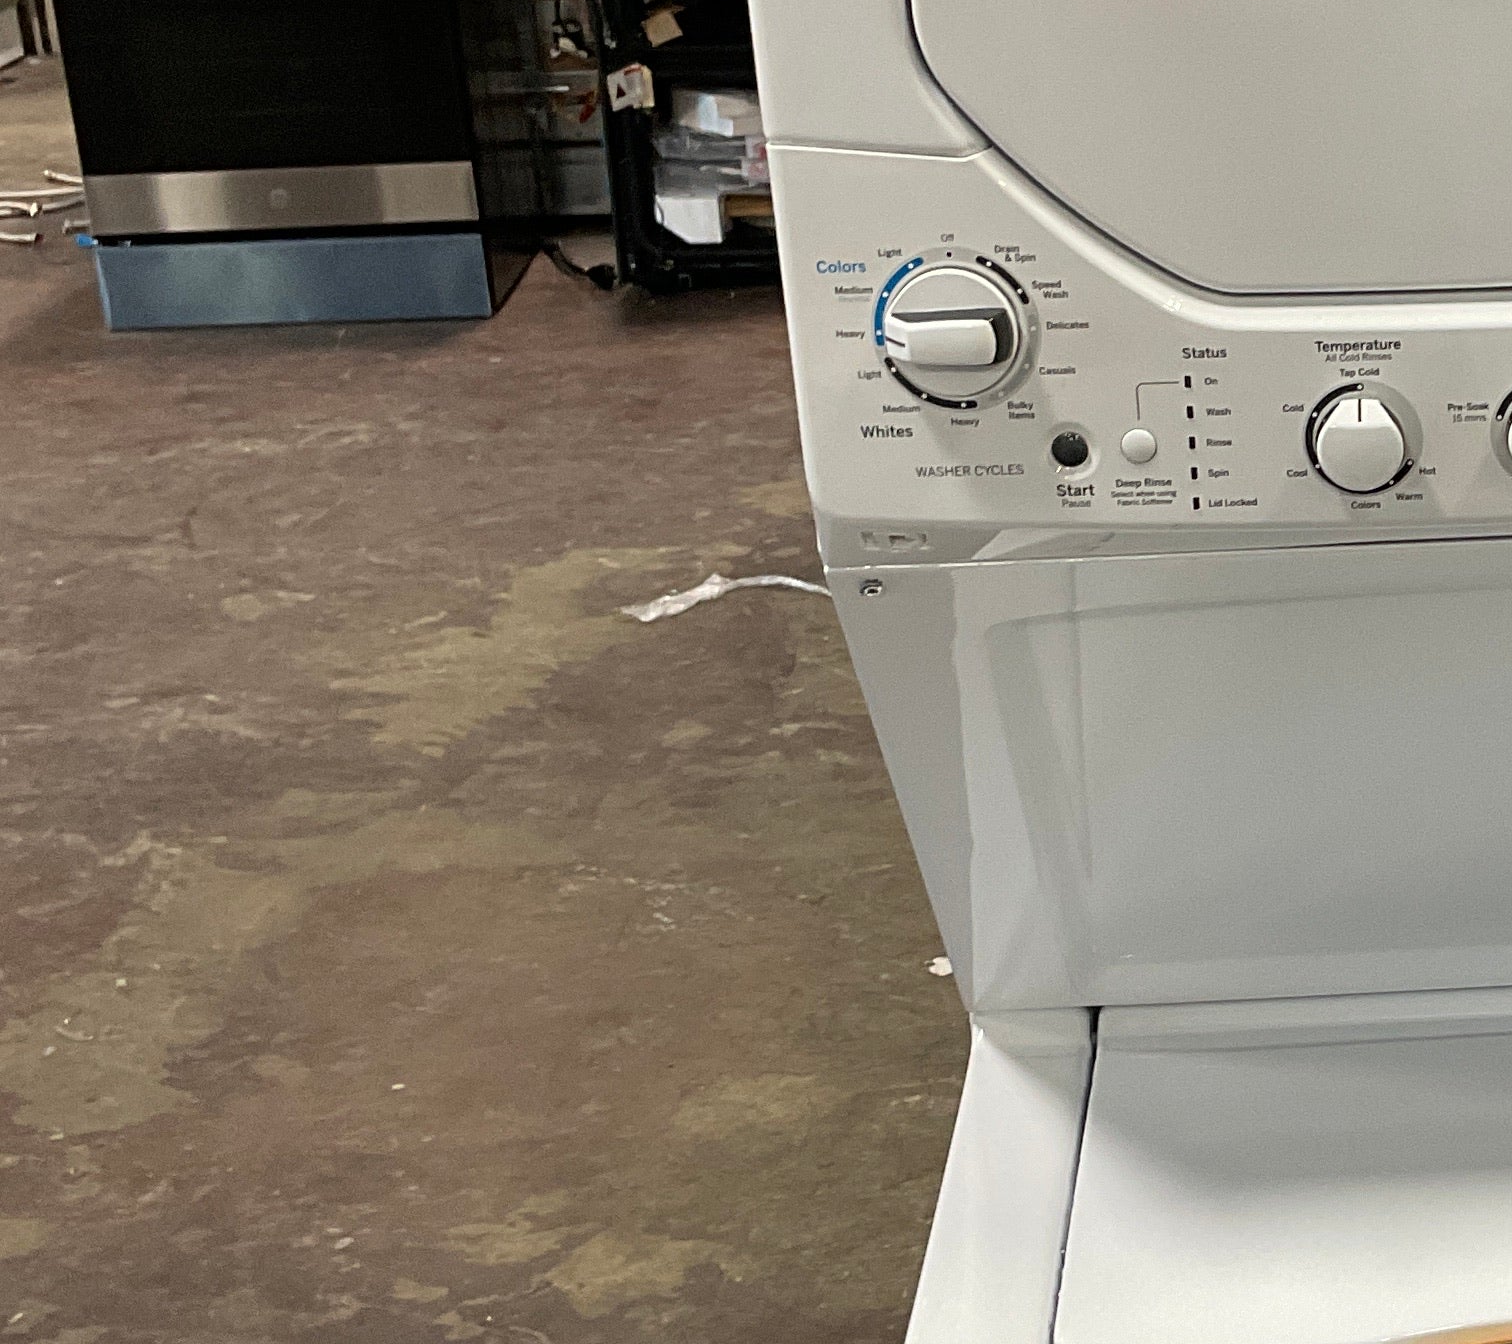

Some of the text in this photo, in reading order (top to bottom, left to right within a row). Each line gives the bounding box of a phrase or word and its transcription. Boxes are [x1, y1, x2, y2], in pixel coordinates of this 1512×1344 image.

[878, 247, 902, 258] Light
[994, 244, 1019, 253] Drain
[1014, 253, 1036, 263] Spin
[816, 260, 867, 274] Colors
[1032, 280, 1061, 290] Speed
[1043, 289, 1068, 298] Wash
[1046, 321, 1089, 330] Delicates
[836, 330, 866, 339] Heavy
[1315, 340, 1401, 354] Temperature
[1182, 348, 1227, 359] Status
[1340, 367, 1380, 378] Tap Cold
[1204, 377, 1218, 386] On
[1206, 408, 1232, 416] Wash
[1282, 404, 1305, 413] Cold
[951, 417, 980, 427] Heavy
[861, 425, 914, 438] Whites
[916, 464, 1025, 478] WASHER CYCLES
[1208, 469, 1230, 479] Spin
[1286, 469, 1308, 478] Cool
[1419, 467, 1436, 475] Hot
[1115, 479, 1142, 489] Deep
[1056, 484, 1095, 497] Start
[1396, 492, 1424, 501] Warm
[1225, 498, 1258, 508] Locked
[1350, 501, 1382, 510] Colors
